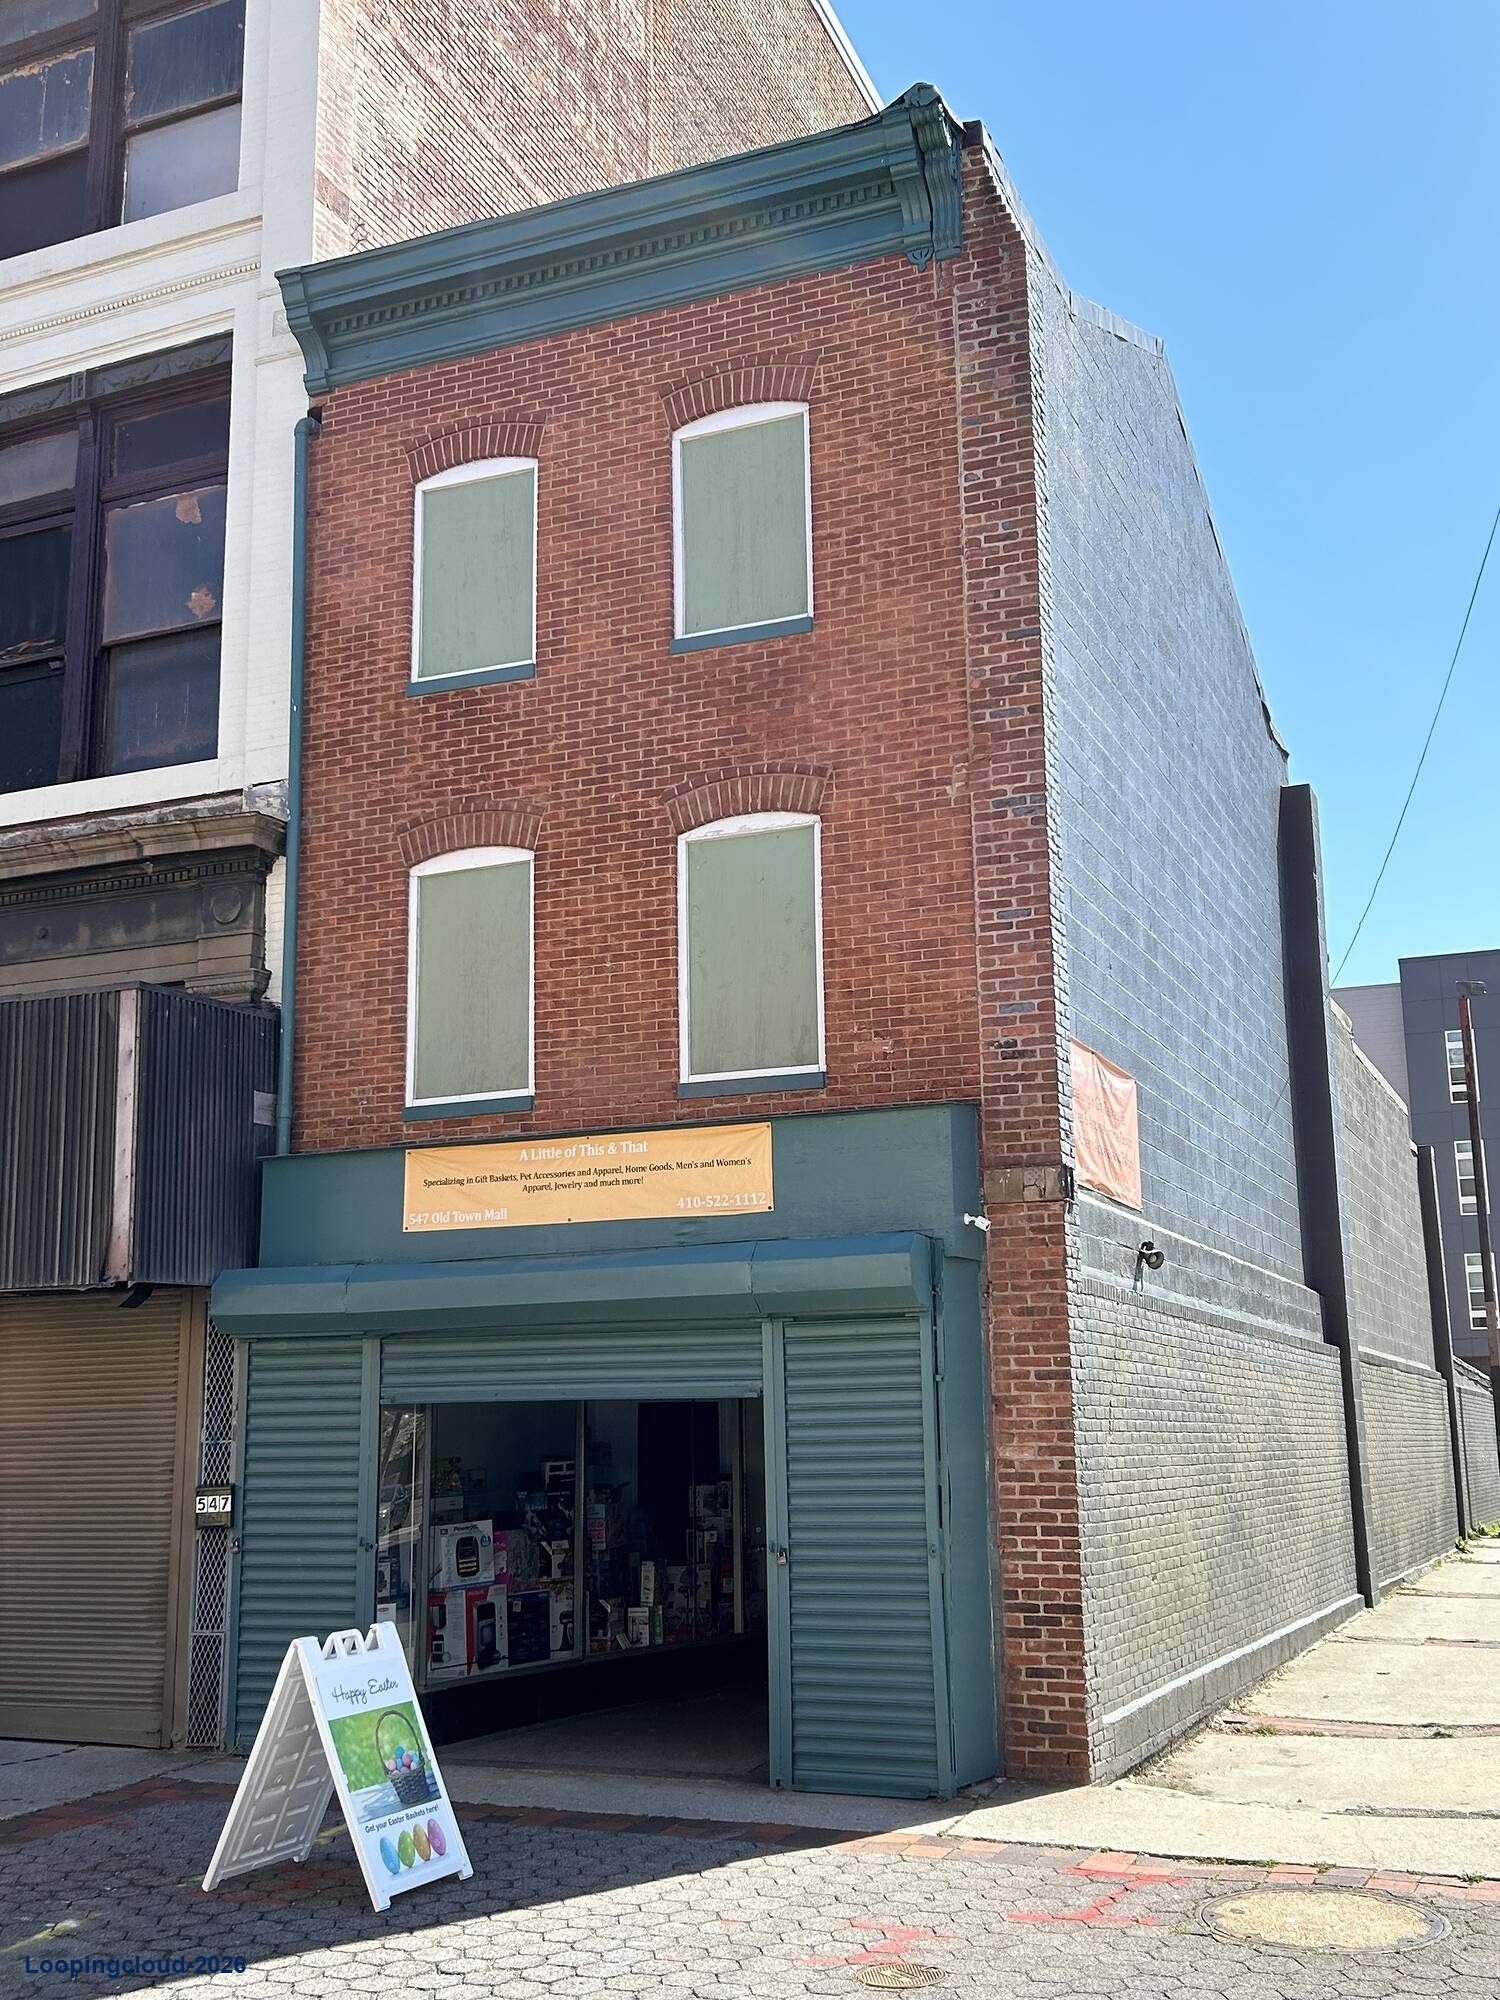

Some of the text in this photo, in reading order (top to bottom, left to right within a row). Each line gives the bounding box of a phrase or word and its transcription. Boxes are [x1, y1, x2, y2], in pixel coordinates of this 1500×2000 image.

[520, 1140, 648, 1161] A Little of This & That
[423, 1156, 752, 1188] Specializing in Gift Baskets, Pet Accessories and Apparel, Home Goods, Men's and Women's
[522, 1176, 644, 1194] Apparel, Jewelry and much more!
[676, 1192, 767, 1209] 410-522-1112
[409, 1207, 508, 1225] 547 Old Town Mall
[197, 1497, 230, 1511] 547
[331, 1677, 399, 1705] Happy Easter
[364, 1803, 439, 1833] Get your Easter Baskets here!
